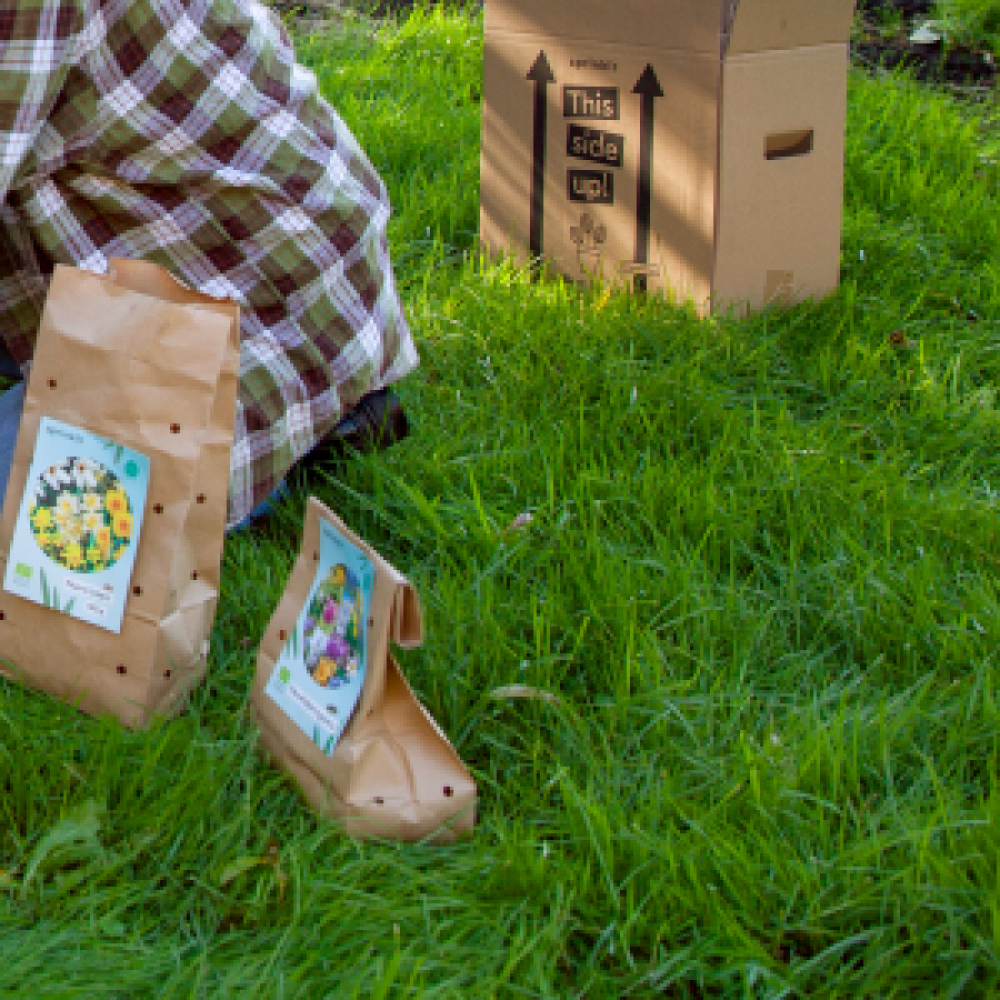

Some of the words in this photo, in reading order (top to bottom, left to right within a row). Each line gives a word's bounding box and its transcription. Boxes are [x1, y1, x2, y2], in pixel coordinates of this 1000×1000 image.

[566, 88, 615, 118] This
[572, 131, 618, 161] side
[573, 173, 608, 200] up!
